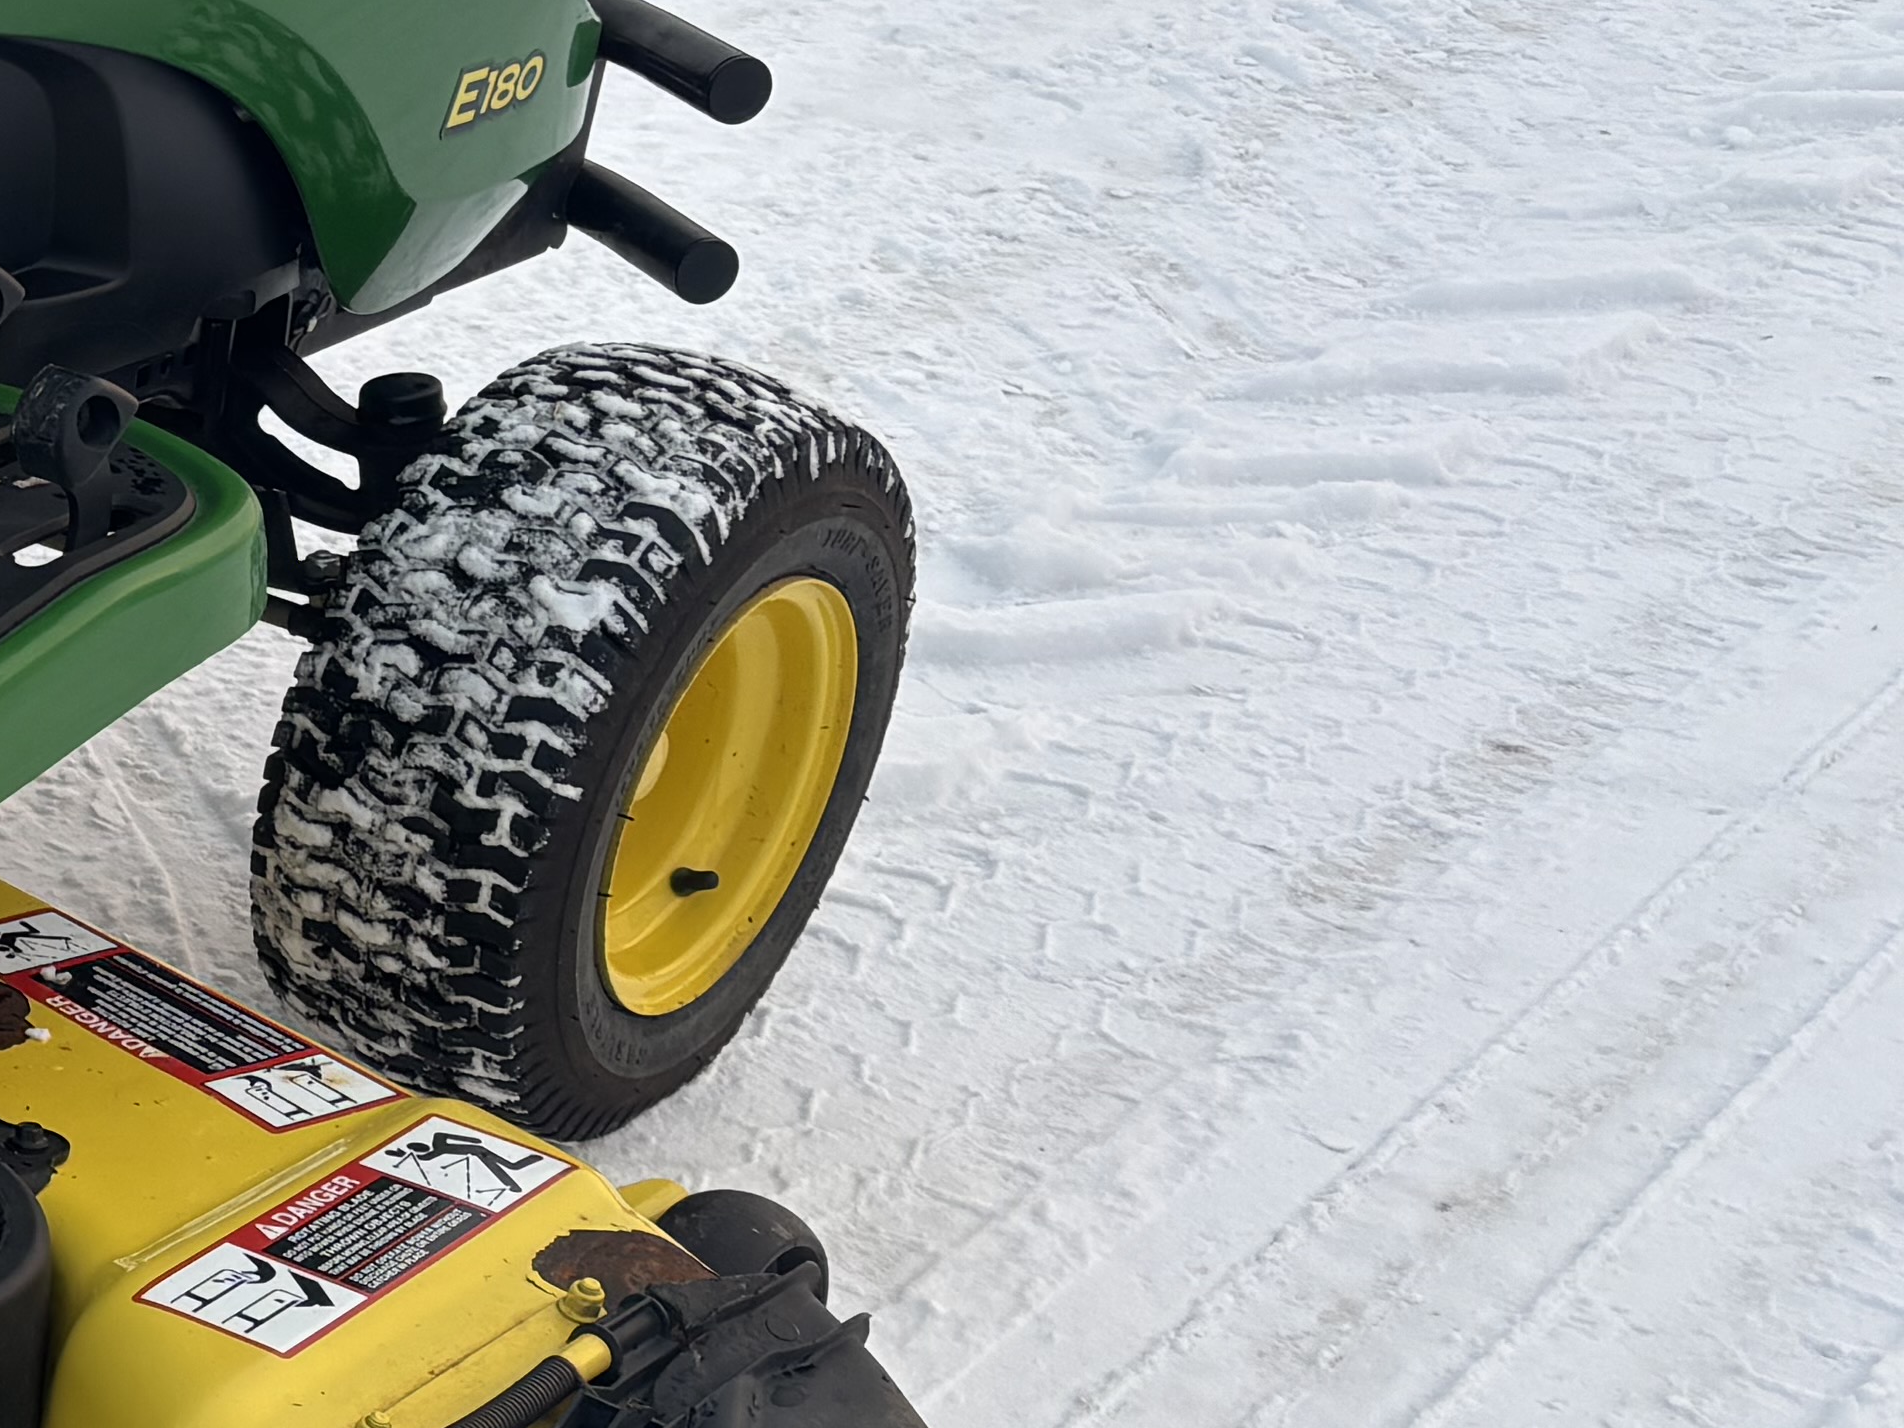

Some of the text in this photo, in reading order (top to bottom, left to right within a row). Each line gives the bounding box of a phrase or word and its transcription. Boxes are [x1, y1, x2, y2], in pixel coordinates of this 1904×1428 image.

[446, 55, 545, 129] E180
[45, 995, 143, 1052] DANGER
[270, 1175, 361, 1227] DANGER
[286, 1188, 375, 1243] ROTATING BLADE
[318, 1199, 413, 1258] THROWN OBJECTS
